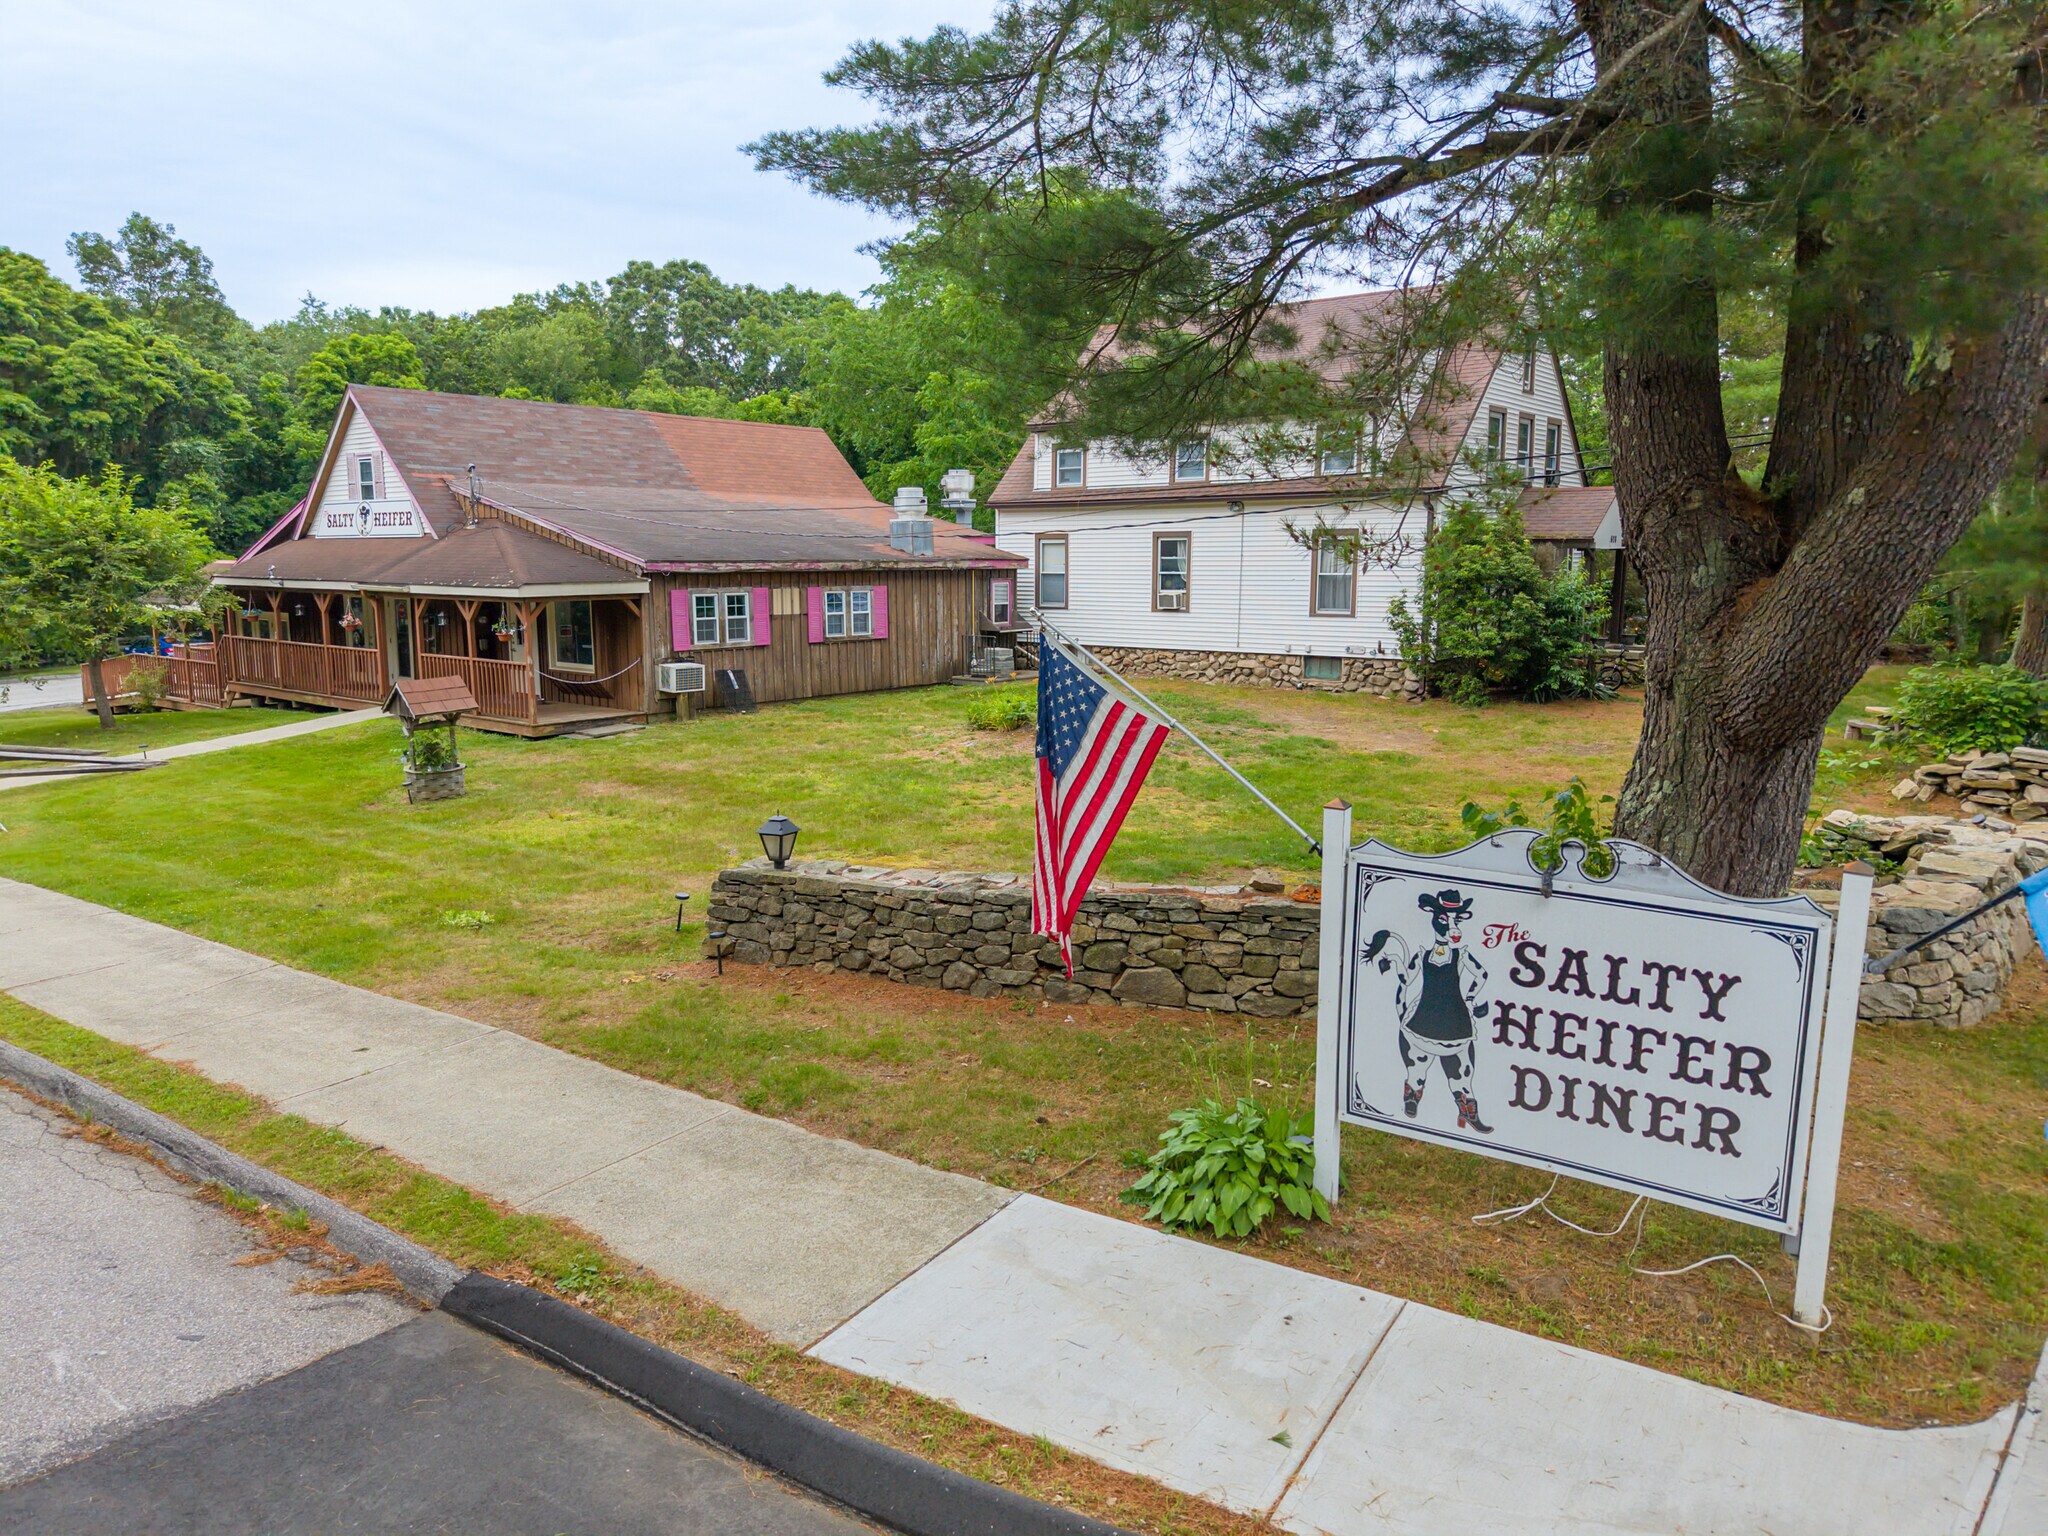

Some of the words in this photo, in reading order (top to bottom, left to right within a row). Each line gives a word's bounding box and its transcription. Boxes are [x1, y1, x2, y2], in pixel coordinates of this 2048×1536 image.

[327, 513, 355, 528] SALTY
[373, 511, 413, 527] HEIFER
[1481, 922, 1531, 949] The
[1509, 940, 1742, 1023] SALTY
[1491, 999, 1773, 1099] HEIFER
[1508, 1064, 1742, 1159] DINER
